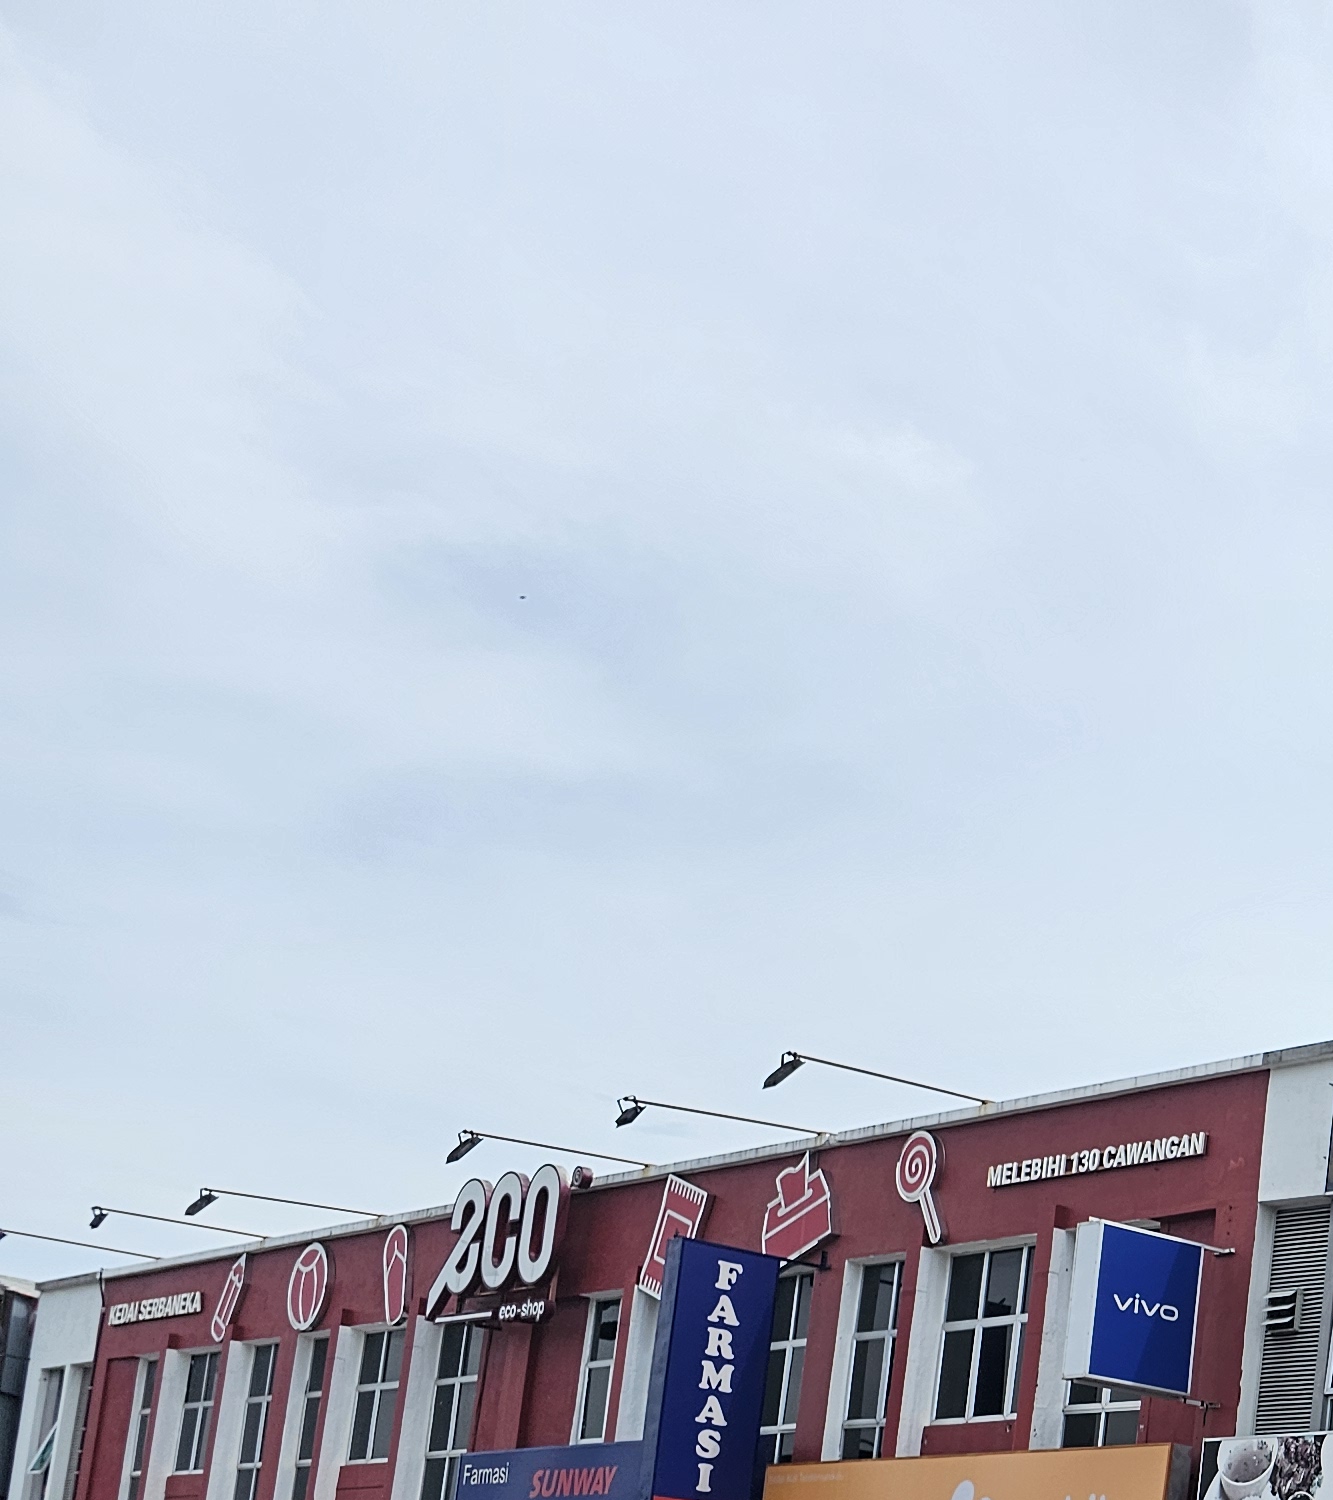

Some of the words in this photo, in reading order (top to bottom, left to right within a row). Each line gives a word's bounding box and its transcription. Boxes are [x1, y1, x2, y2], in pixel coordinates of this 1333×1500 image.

[986, 1151, 1066, 1188] MELEBIHI
[1067, 1148, 1101, 1175] 130
[1103, 1131, 1207, 1169] CAWANGAN
[108, 1301, 140, 1326] KEDAI
[138, 1291, 202, 1321] SERBANEKA
[498, 1300, 545, 1322] eco-shop
[1113, 1293, 1180, 1322] vivo
[694, 1257, 745, 1494] FARMASI
[462, 1462, 509, 1486] Farmasi
[529, 1465, 617, 1499] SUNWAY
